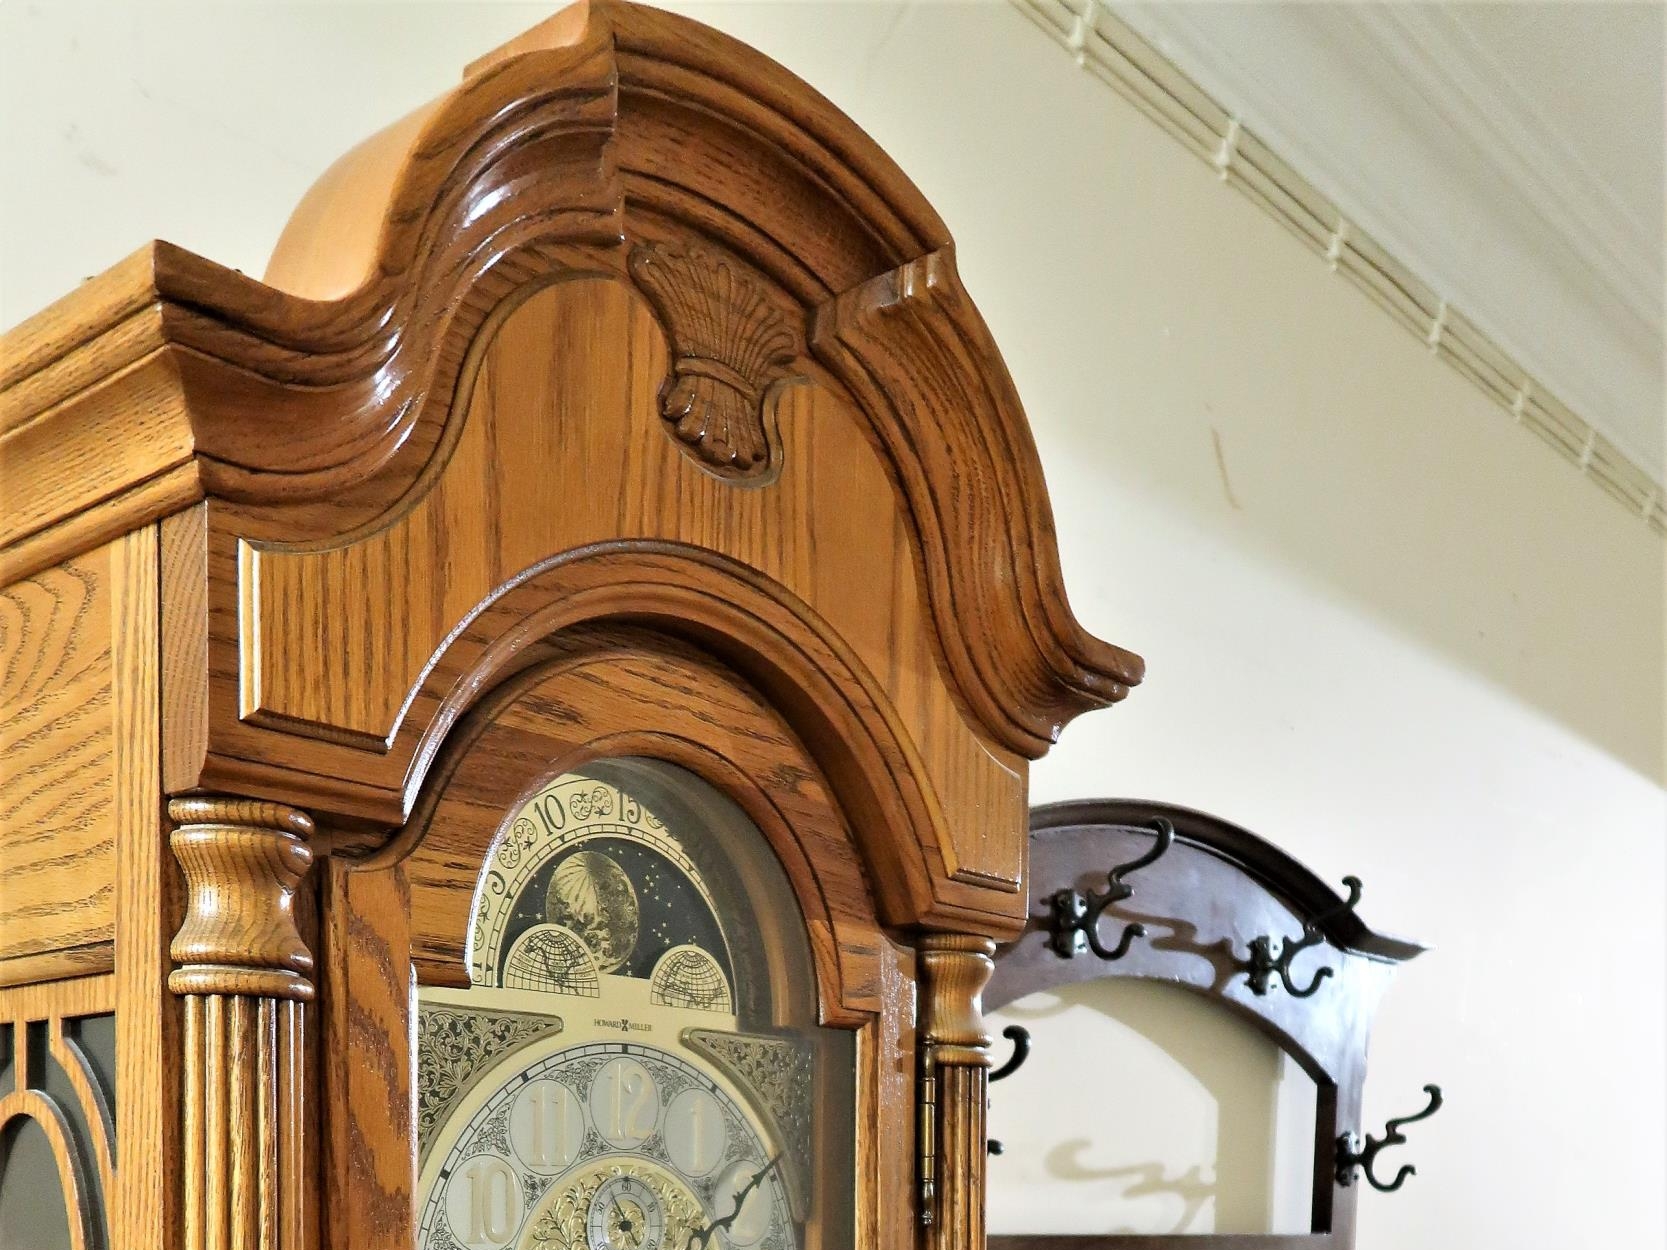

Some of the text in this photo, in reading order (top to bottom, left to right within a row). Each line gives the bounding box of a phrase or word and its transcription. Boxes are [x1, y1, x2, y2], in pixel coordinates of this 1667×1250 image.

[534, 794, 566, 836] 10
[528, 1085, 569, 1166] 11
[607, 1062, 655, 1141] 12
[690, 1099, 705, 1172] 1
[466, 1162, 516, 1245] 10
